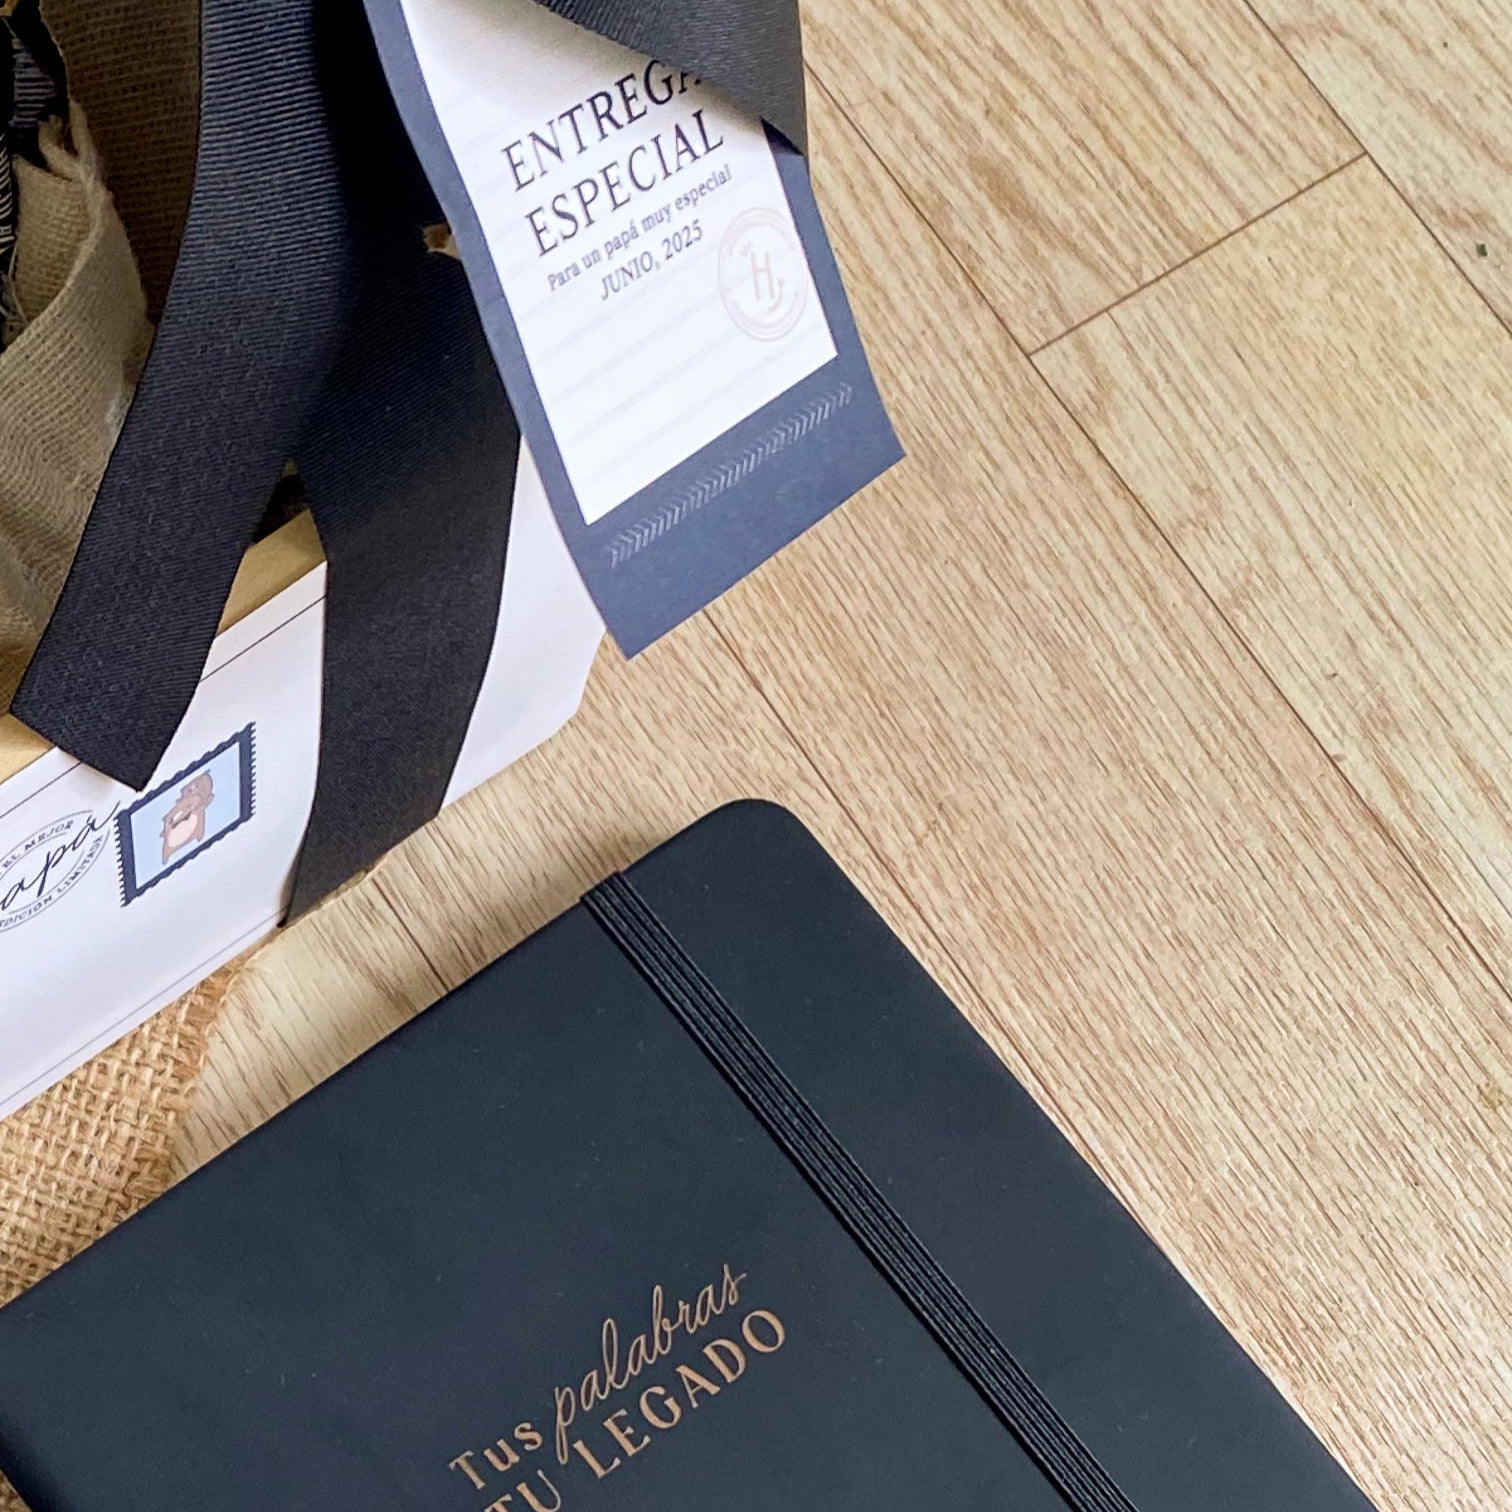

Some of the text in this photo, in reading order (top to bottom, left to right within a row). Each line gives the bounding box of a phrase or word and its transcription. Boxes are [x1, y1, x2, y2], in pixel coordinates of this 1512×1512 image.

[525, 108, 723, 257] ESPECIAL
[547, 164, 732, 292] Para un papá muy especial
[600, 251, 660, 300] JUNIO,
[661, 219, 704, 261] 2025
[448, 1262, 748, 1491] Tus palabras
[571, 1308, 787, 1480] LEGADO
